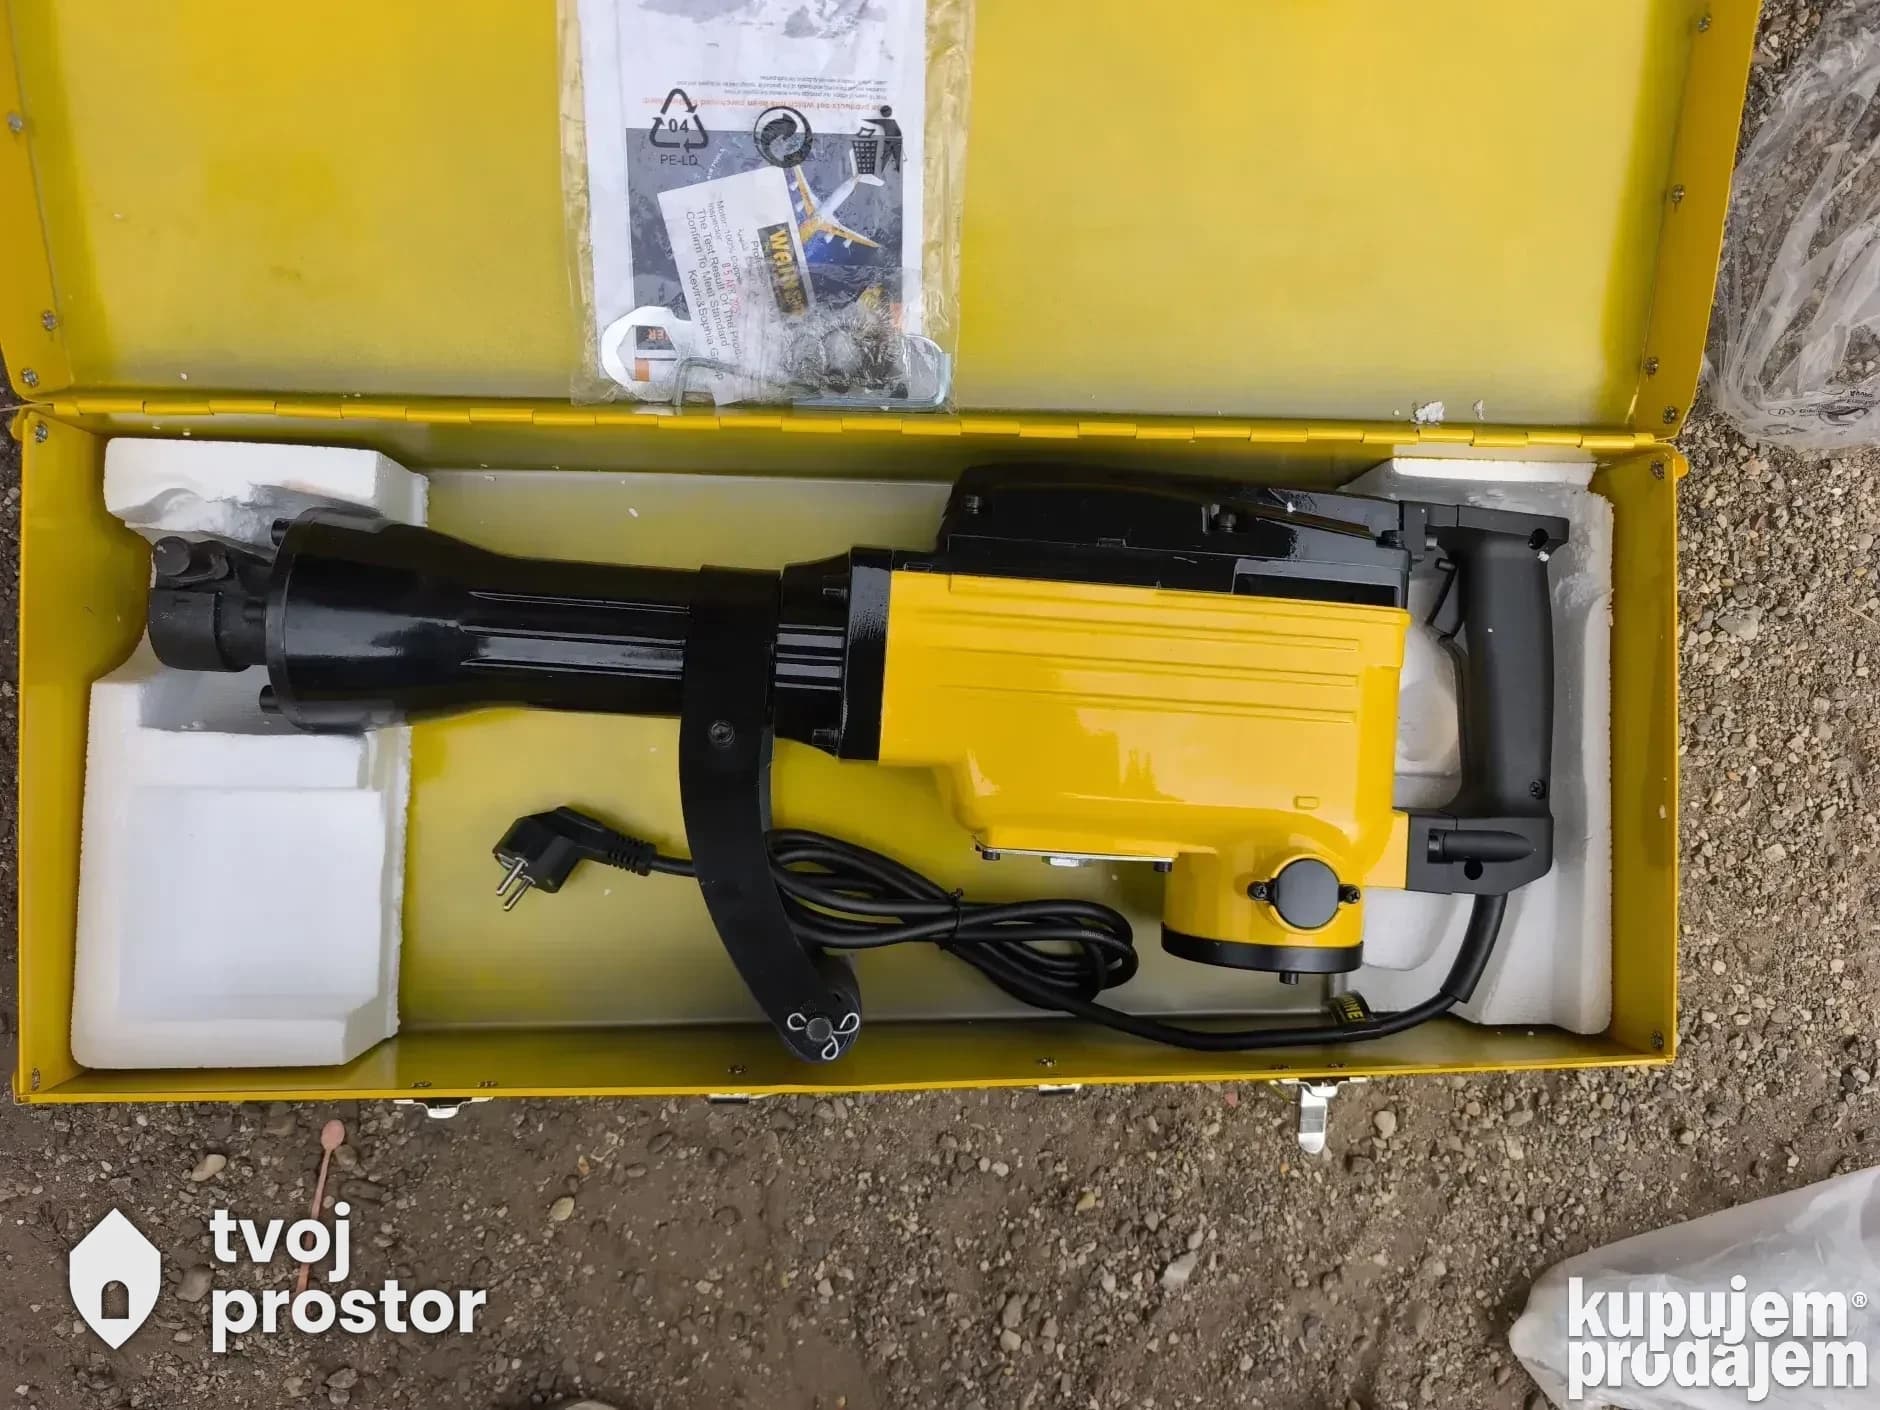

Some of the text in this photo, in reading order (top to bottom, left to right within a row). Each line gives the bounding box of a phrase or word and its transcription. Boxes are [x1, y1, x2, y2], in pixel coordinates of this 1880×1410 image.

[669, 118, 689, 133] 04
[660, 154, 698, 166] PE-LD
[696, 208, 709, 230] The
[703, 232, 716, 254] Test
[685, 210, 730, 347] Confirm To Meet Standard
[709, 256, 726, 289] Result
